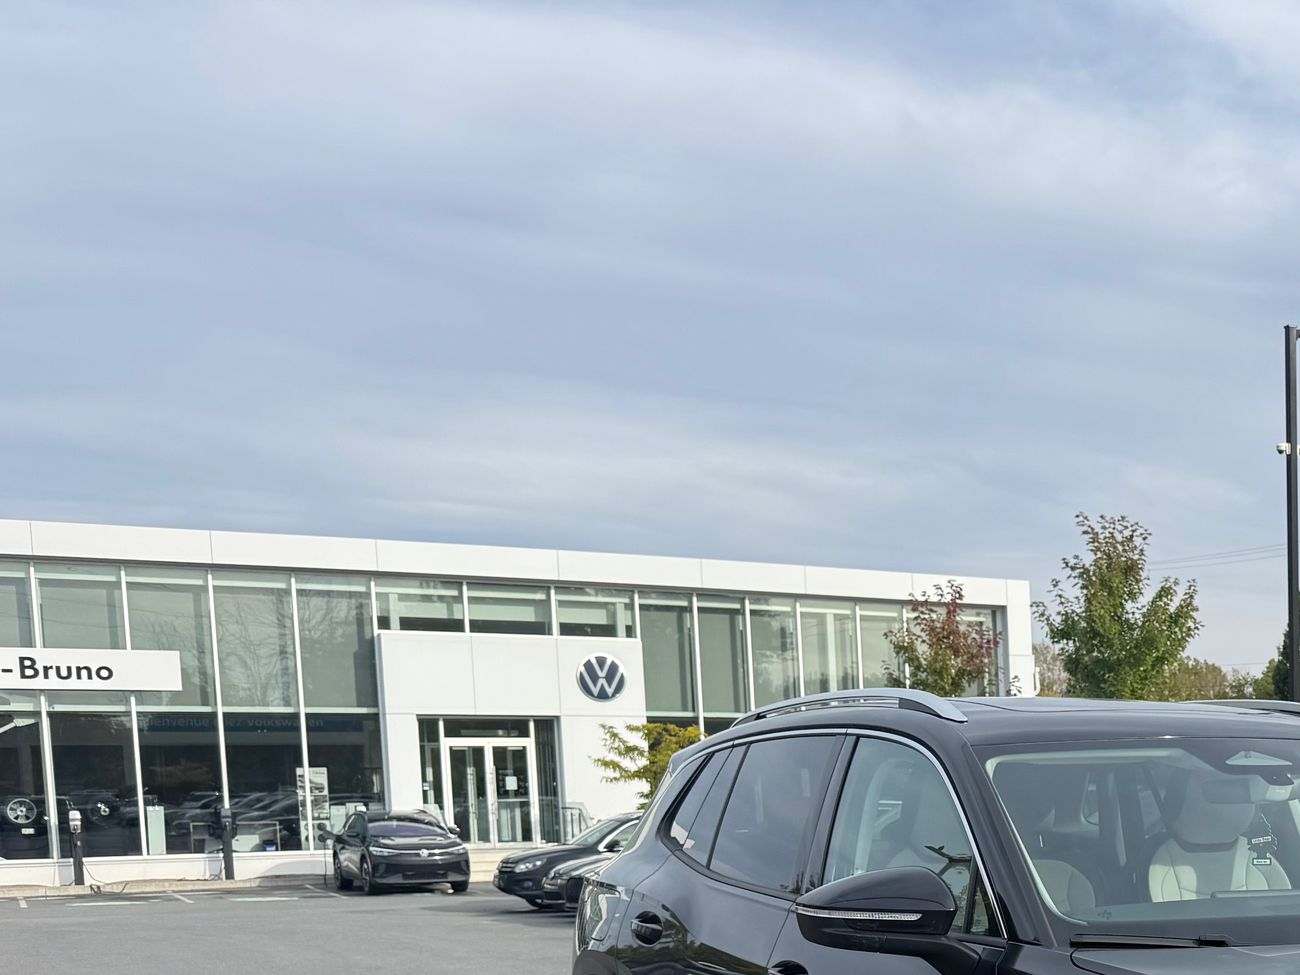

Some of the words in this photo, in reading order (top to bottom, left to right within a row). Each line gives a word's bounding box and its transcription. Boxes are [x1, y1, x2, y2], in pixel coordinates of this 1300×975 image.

[1, 656, 114, 681] -Bruno
[145, 716, 210, 727] ienvenue
[247, 717, 324, 728] Volkswaen
